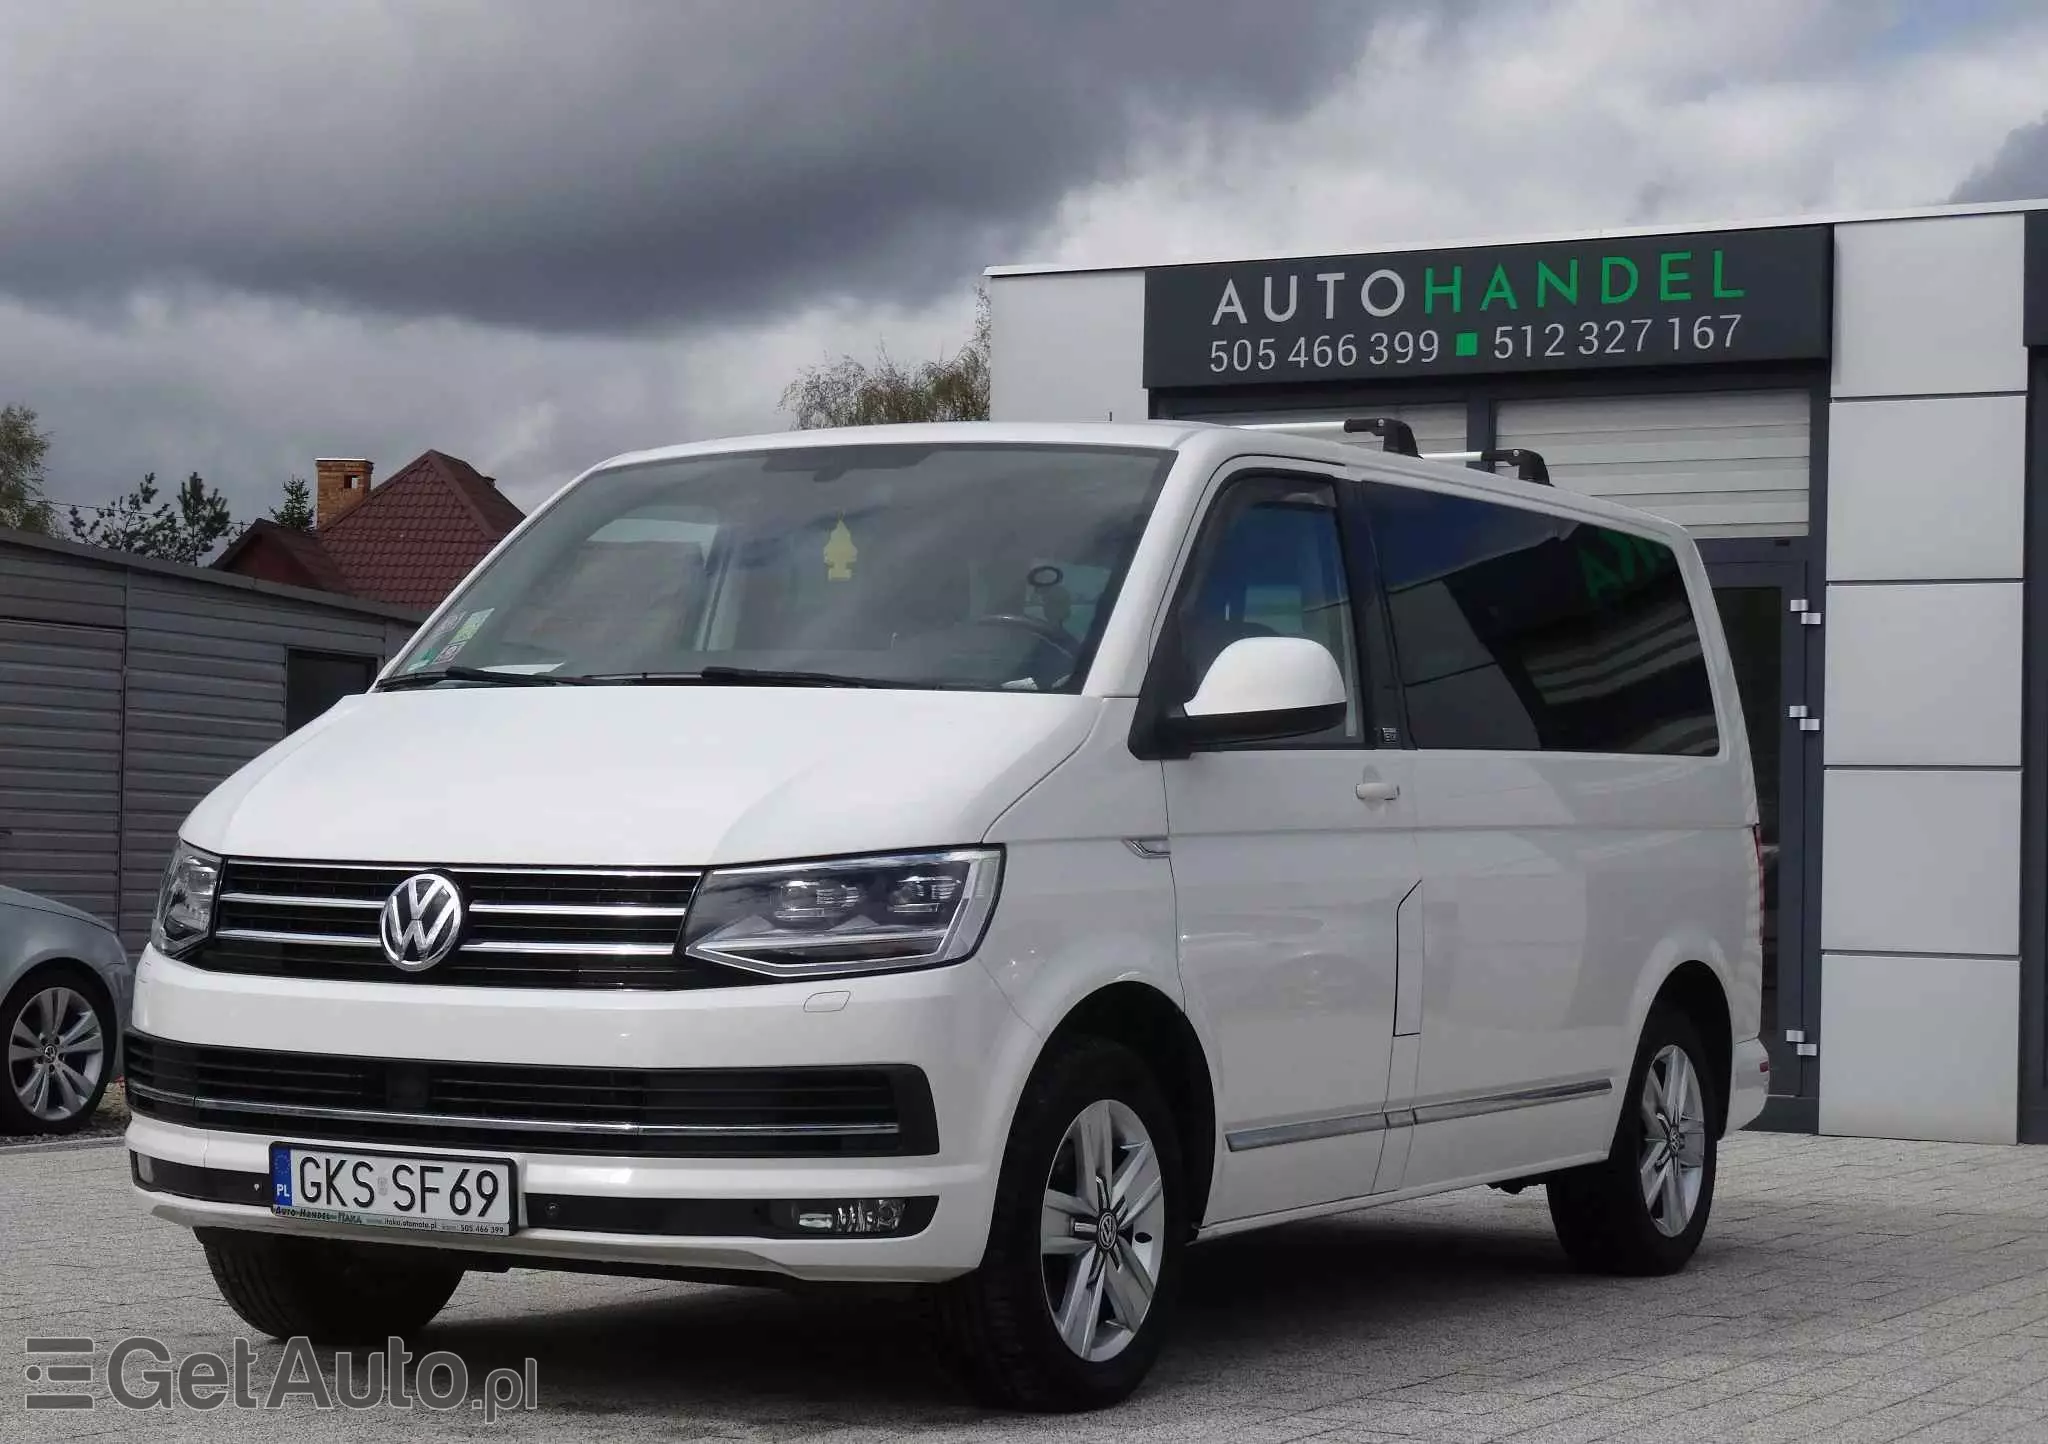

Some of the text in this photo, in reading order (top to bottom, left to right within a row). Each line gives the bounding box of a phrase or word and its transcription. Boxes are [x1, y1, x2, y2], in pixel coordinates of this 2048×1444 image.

[1209, 313, 1742, 373] 505 466 399 512 327 167
[276, 1183, 291, 1198] PL
[299, 1156, 500, 1218] GKS SF69
[460, 1224, 474, 1233] 505
[475, 1225, 489, 1234] 466
[491, 1226, 504, 1235] 399
